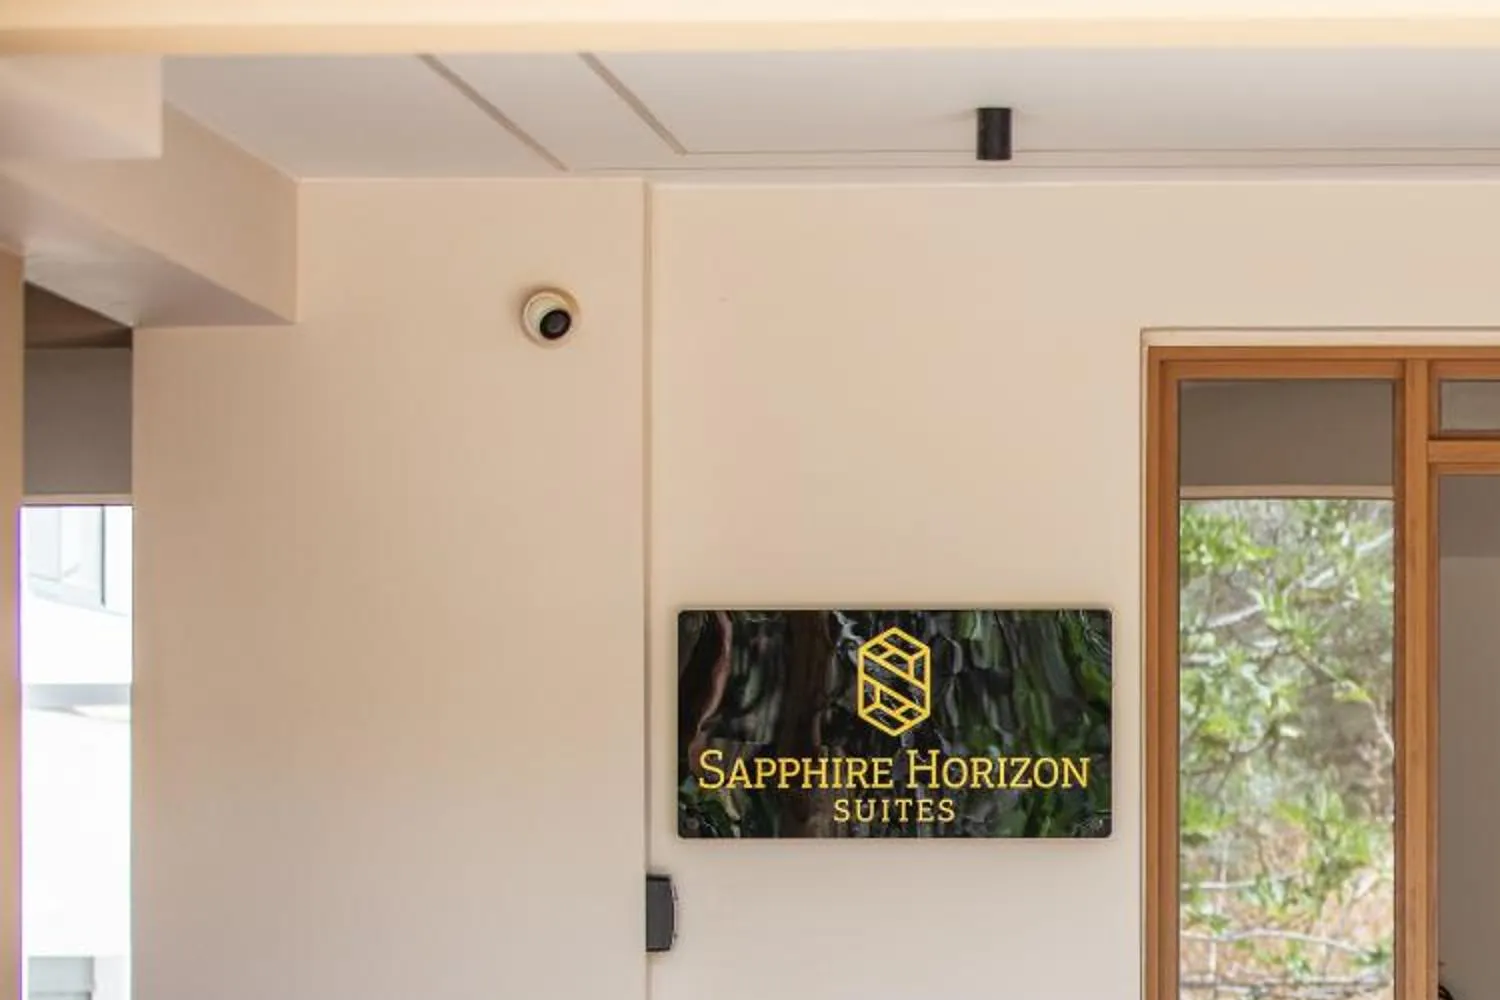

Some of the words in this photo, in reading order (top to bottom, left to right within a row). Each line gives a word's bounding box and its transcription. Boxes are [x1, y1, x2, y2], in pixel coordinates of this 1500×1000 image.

[699, 749, 893, 789] SAPPHIRE
[906, 749, 1090, 788] HORIZON
[833, 799, 955, 822] SUITES
